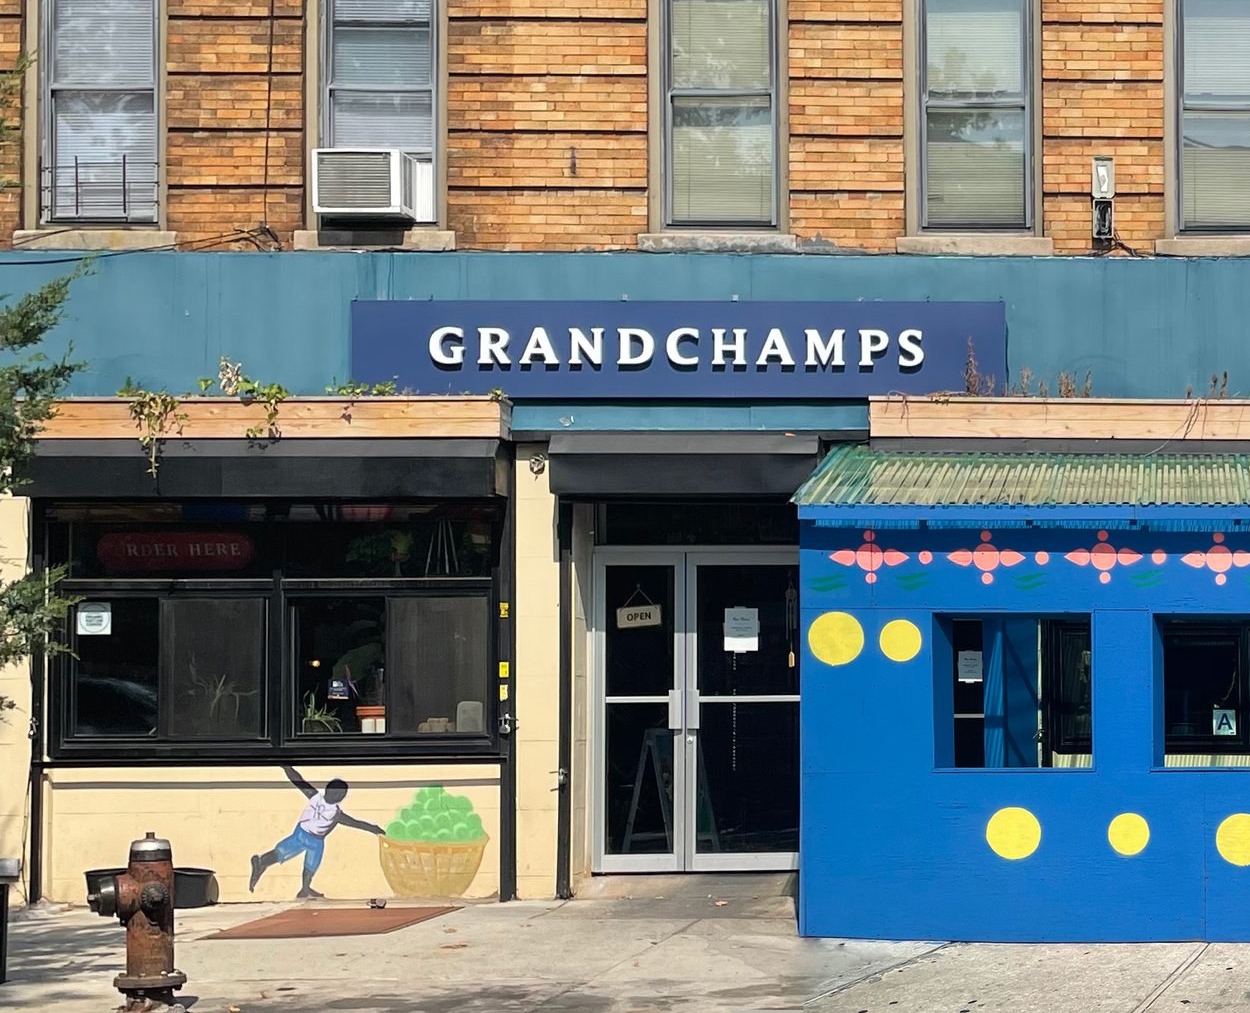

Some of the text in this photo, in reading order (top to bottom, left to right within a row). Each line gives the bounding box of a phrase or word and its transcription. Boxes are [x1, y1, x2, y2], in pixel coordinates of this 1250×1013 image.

[428, 326, 925, 370] GRANDCHAMPS
[117, 543, 241, 556] RDER HERE
[626, 612, 652, 622] OPEN
[1217, 713, 1234, 730] A
